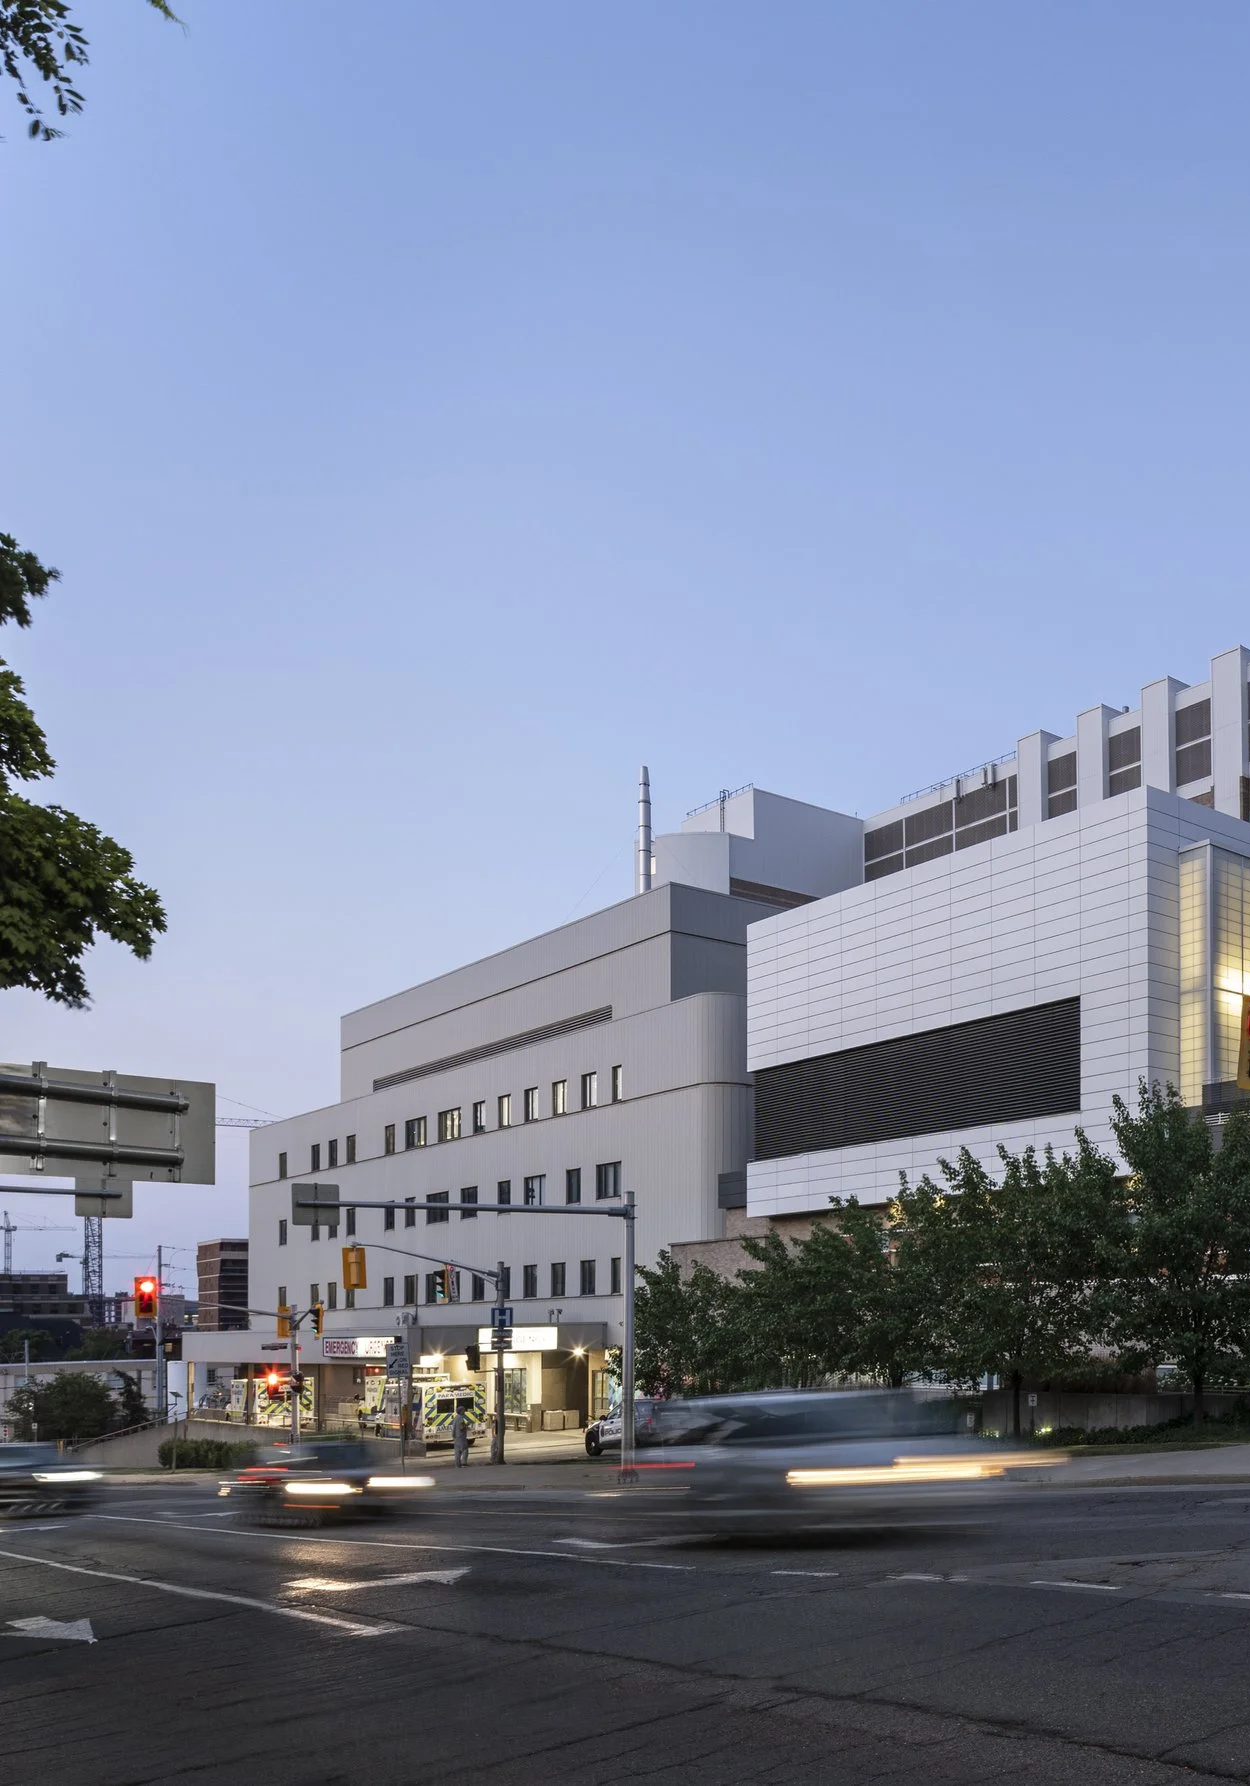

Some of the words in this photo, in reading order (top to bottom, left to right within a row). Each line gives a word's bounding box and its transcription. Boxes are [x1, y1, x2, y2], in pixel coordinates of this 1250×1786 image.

[494, 1309, 511, 1326] H
[325, 1340, 358, 1354] EMERGENCY
[604, 1428, 622, 1436] POLIC
